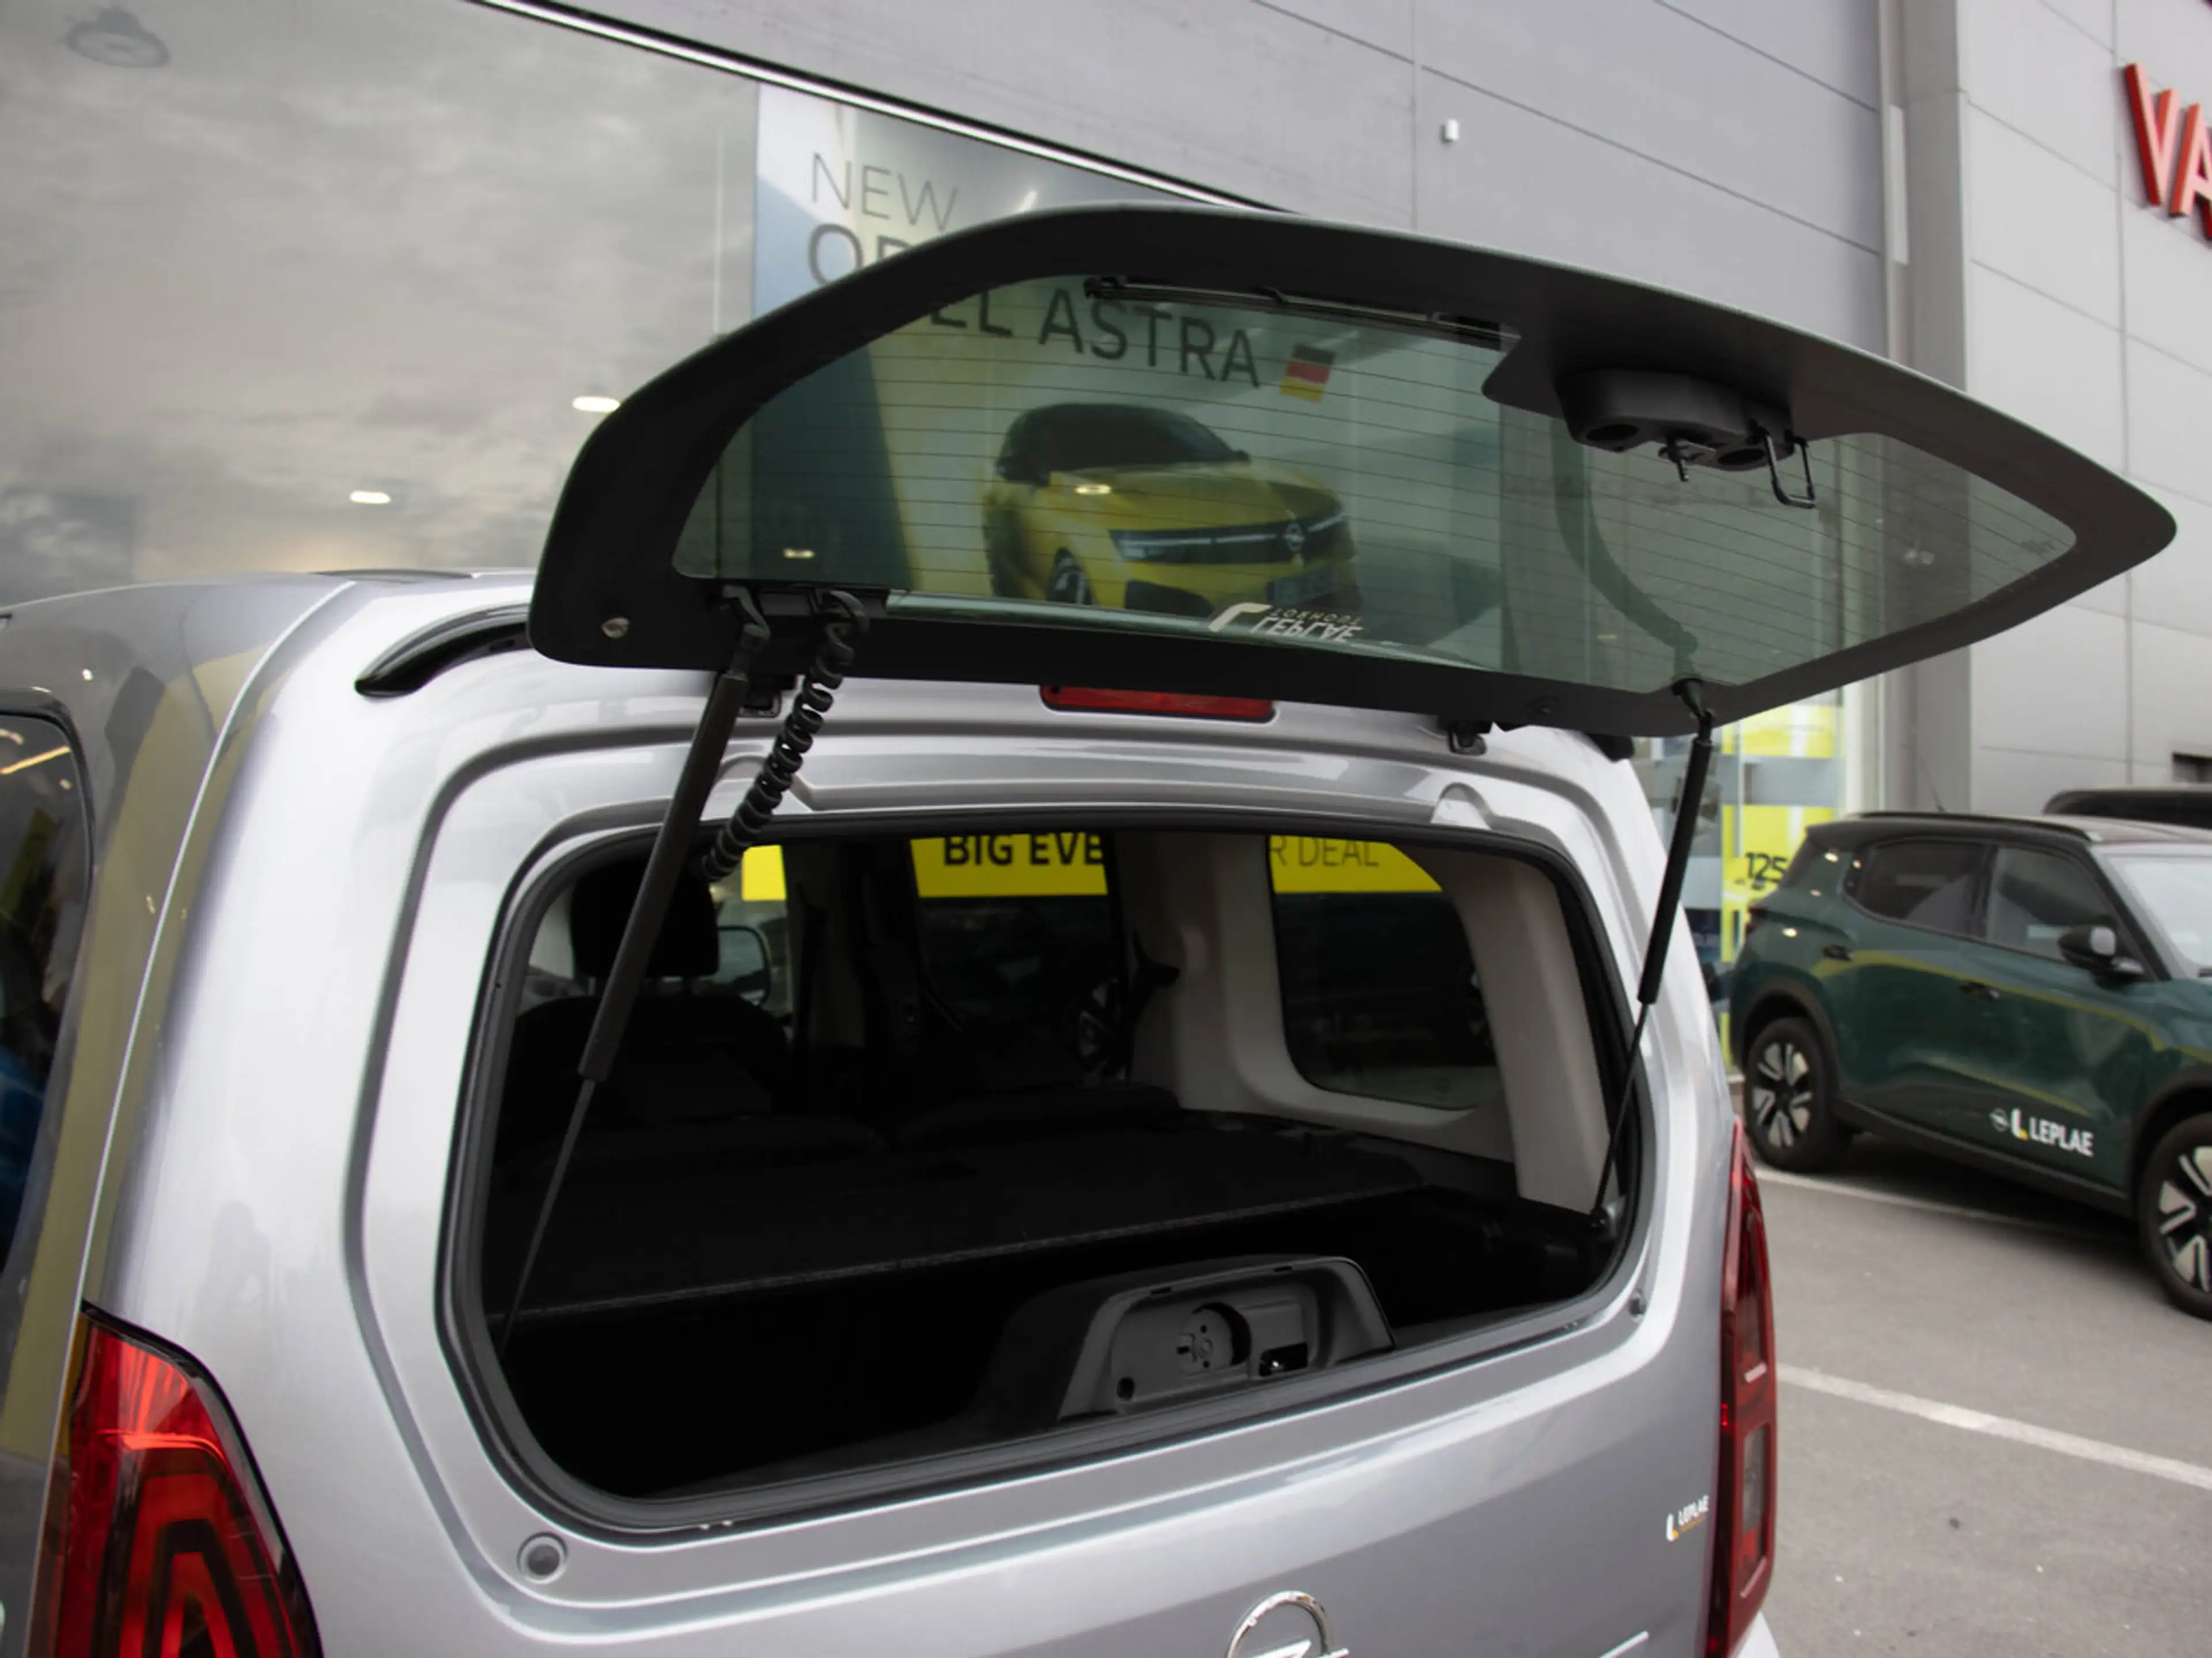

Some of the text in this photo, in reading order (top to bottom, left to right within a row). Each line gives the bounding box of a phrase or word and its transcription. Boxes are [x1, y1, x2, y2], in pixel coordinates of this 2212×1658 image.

[812, 151, 957, 232] NEW
[1040, 289, 1260, 388] ASTRA
[943, 835, 1013, 866] BIG
[1298, 837, 1380, 868] DEAL
[2029, 1117, 2094, 1158] LEPLAE
